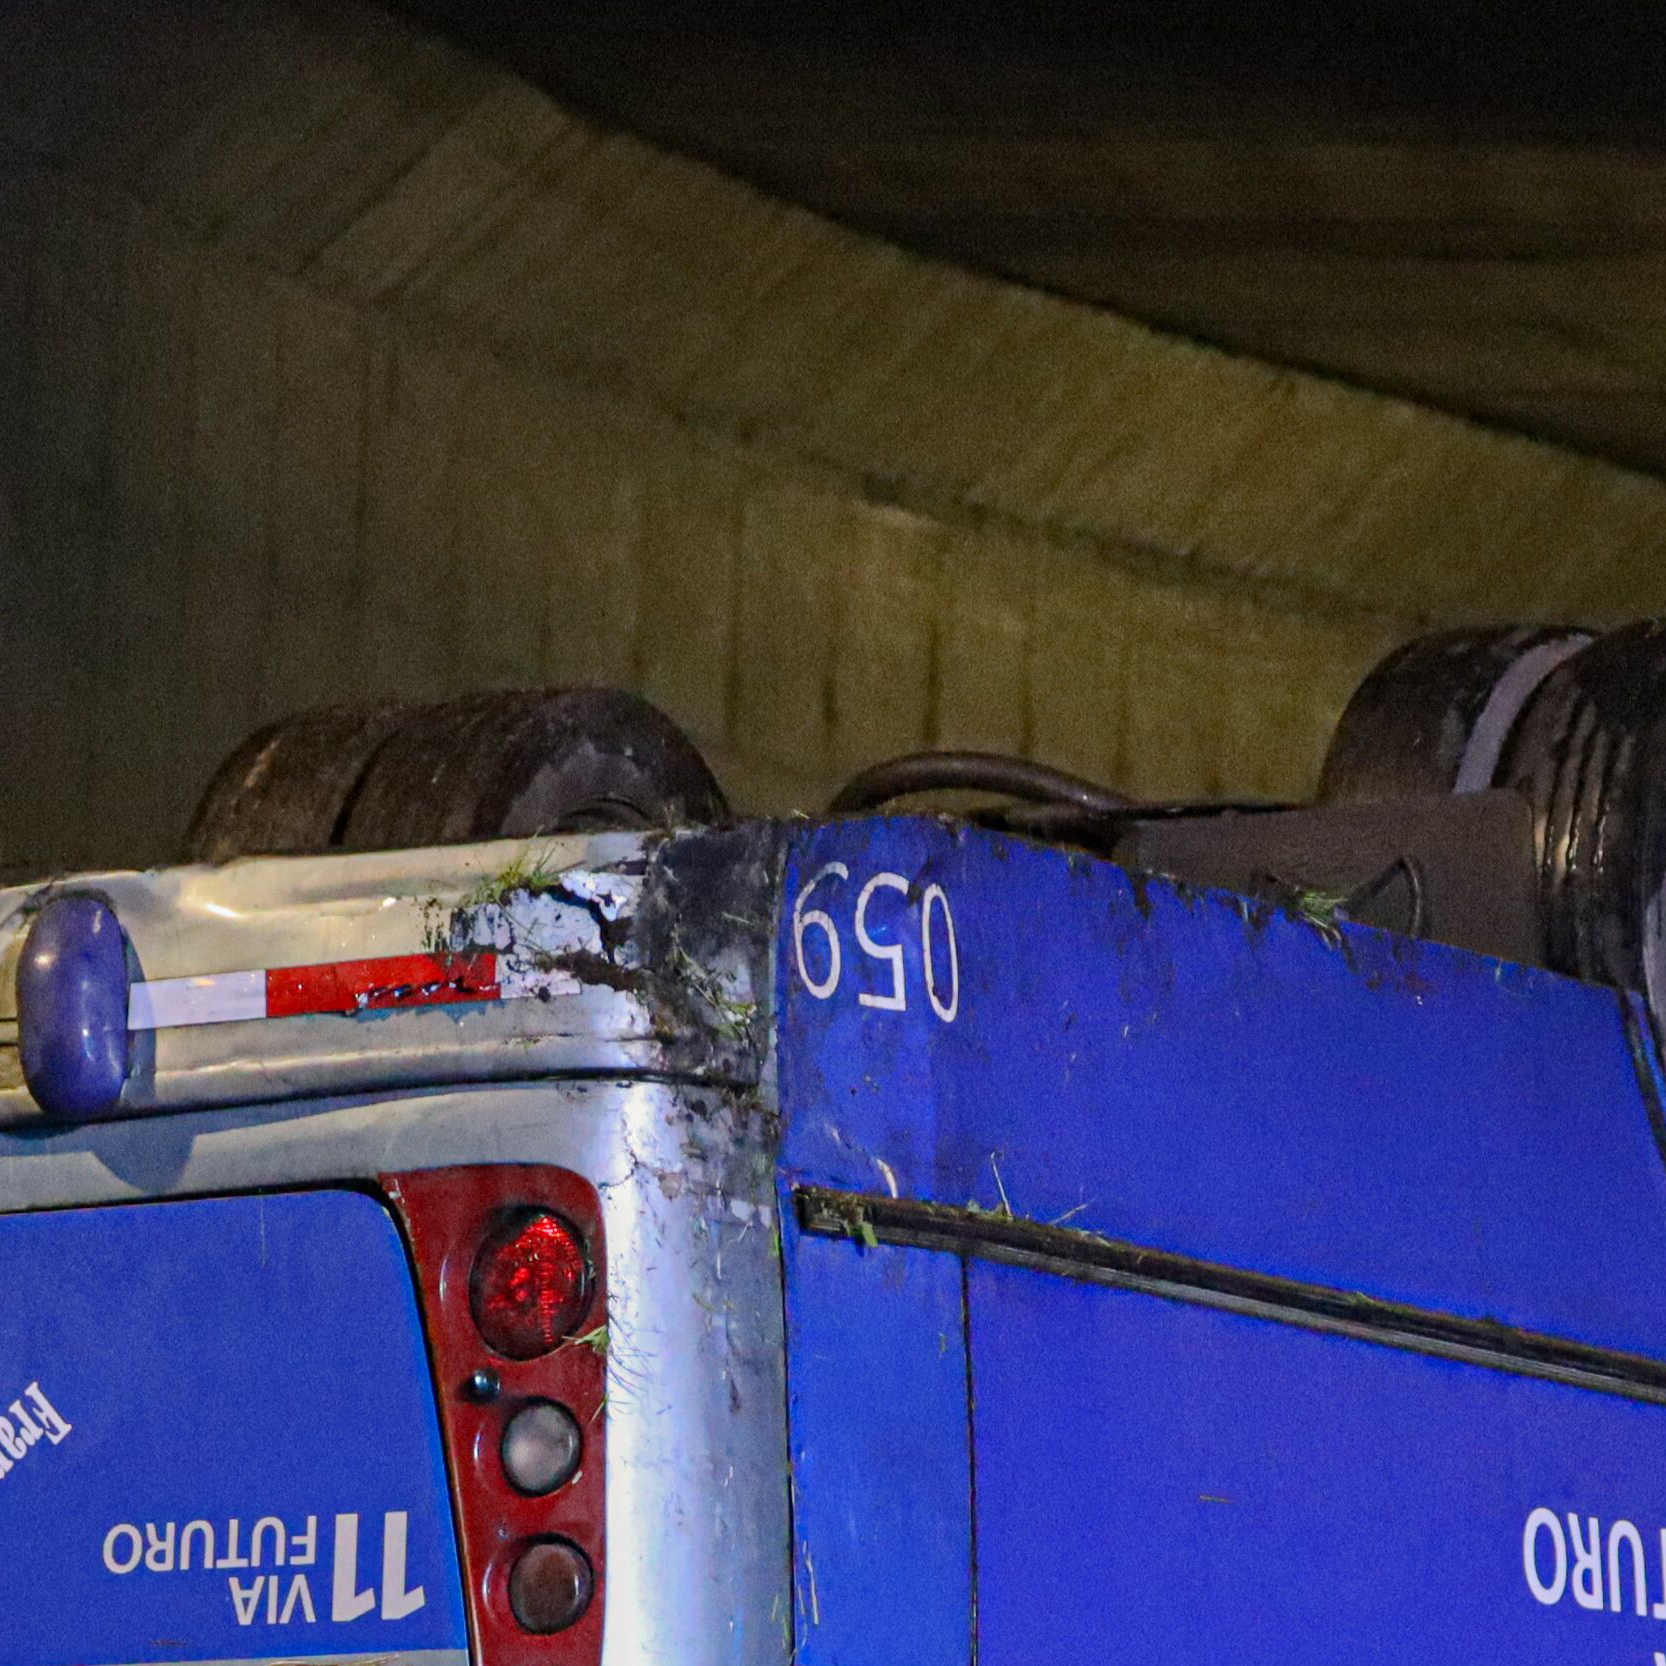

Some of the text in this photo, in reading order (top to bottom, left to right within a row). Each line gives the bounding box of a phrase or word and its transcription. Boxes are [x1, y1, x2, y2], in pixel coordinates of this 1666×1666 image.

[792, 862, 960, 1024] 059
[103, 1514, 317, 1575] FUTURO
[332, 1511, 425, 1623] 11
[228, 1575, 316, 1626] VIA
